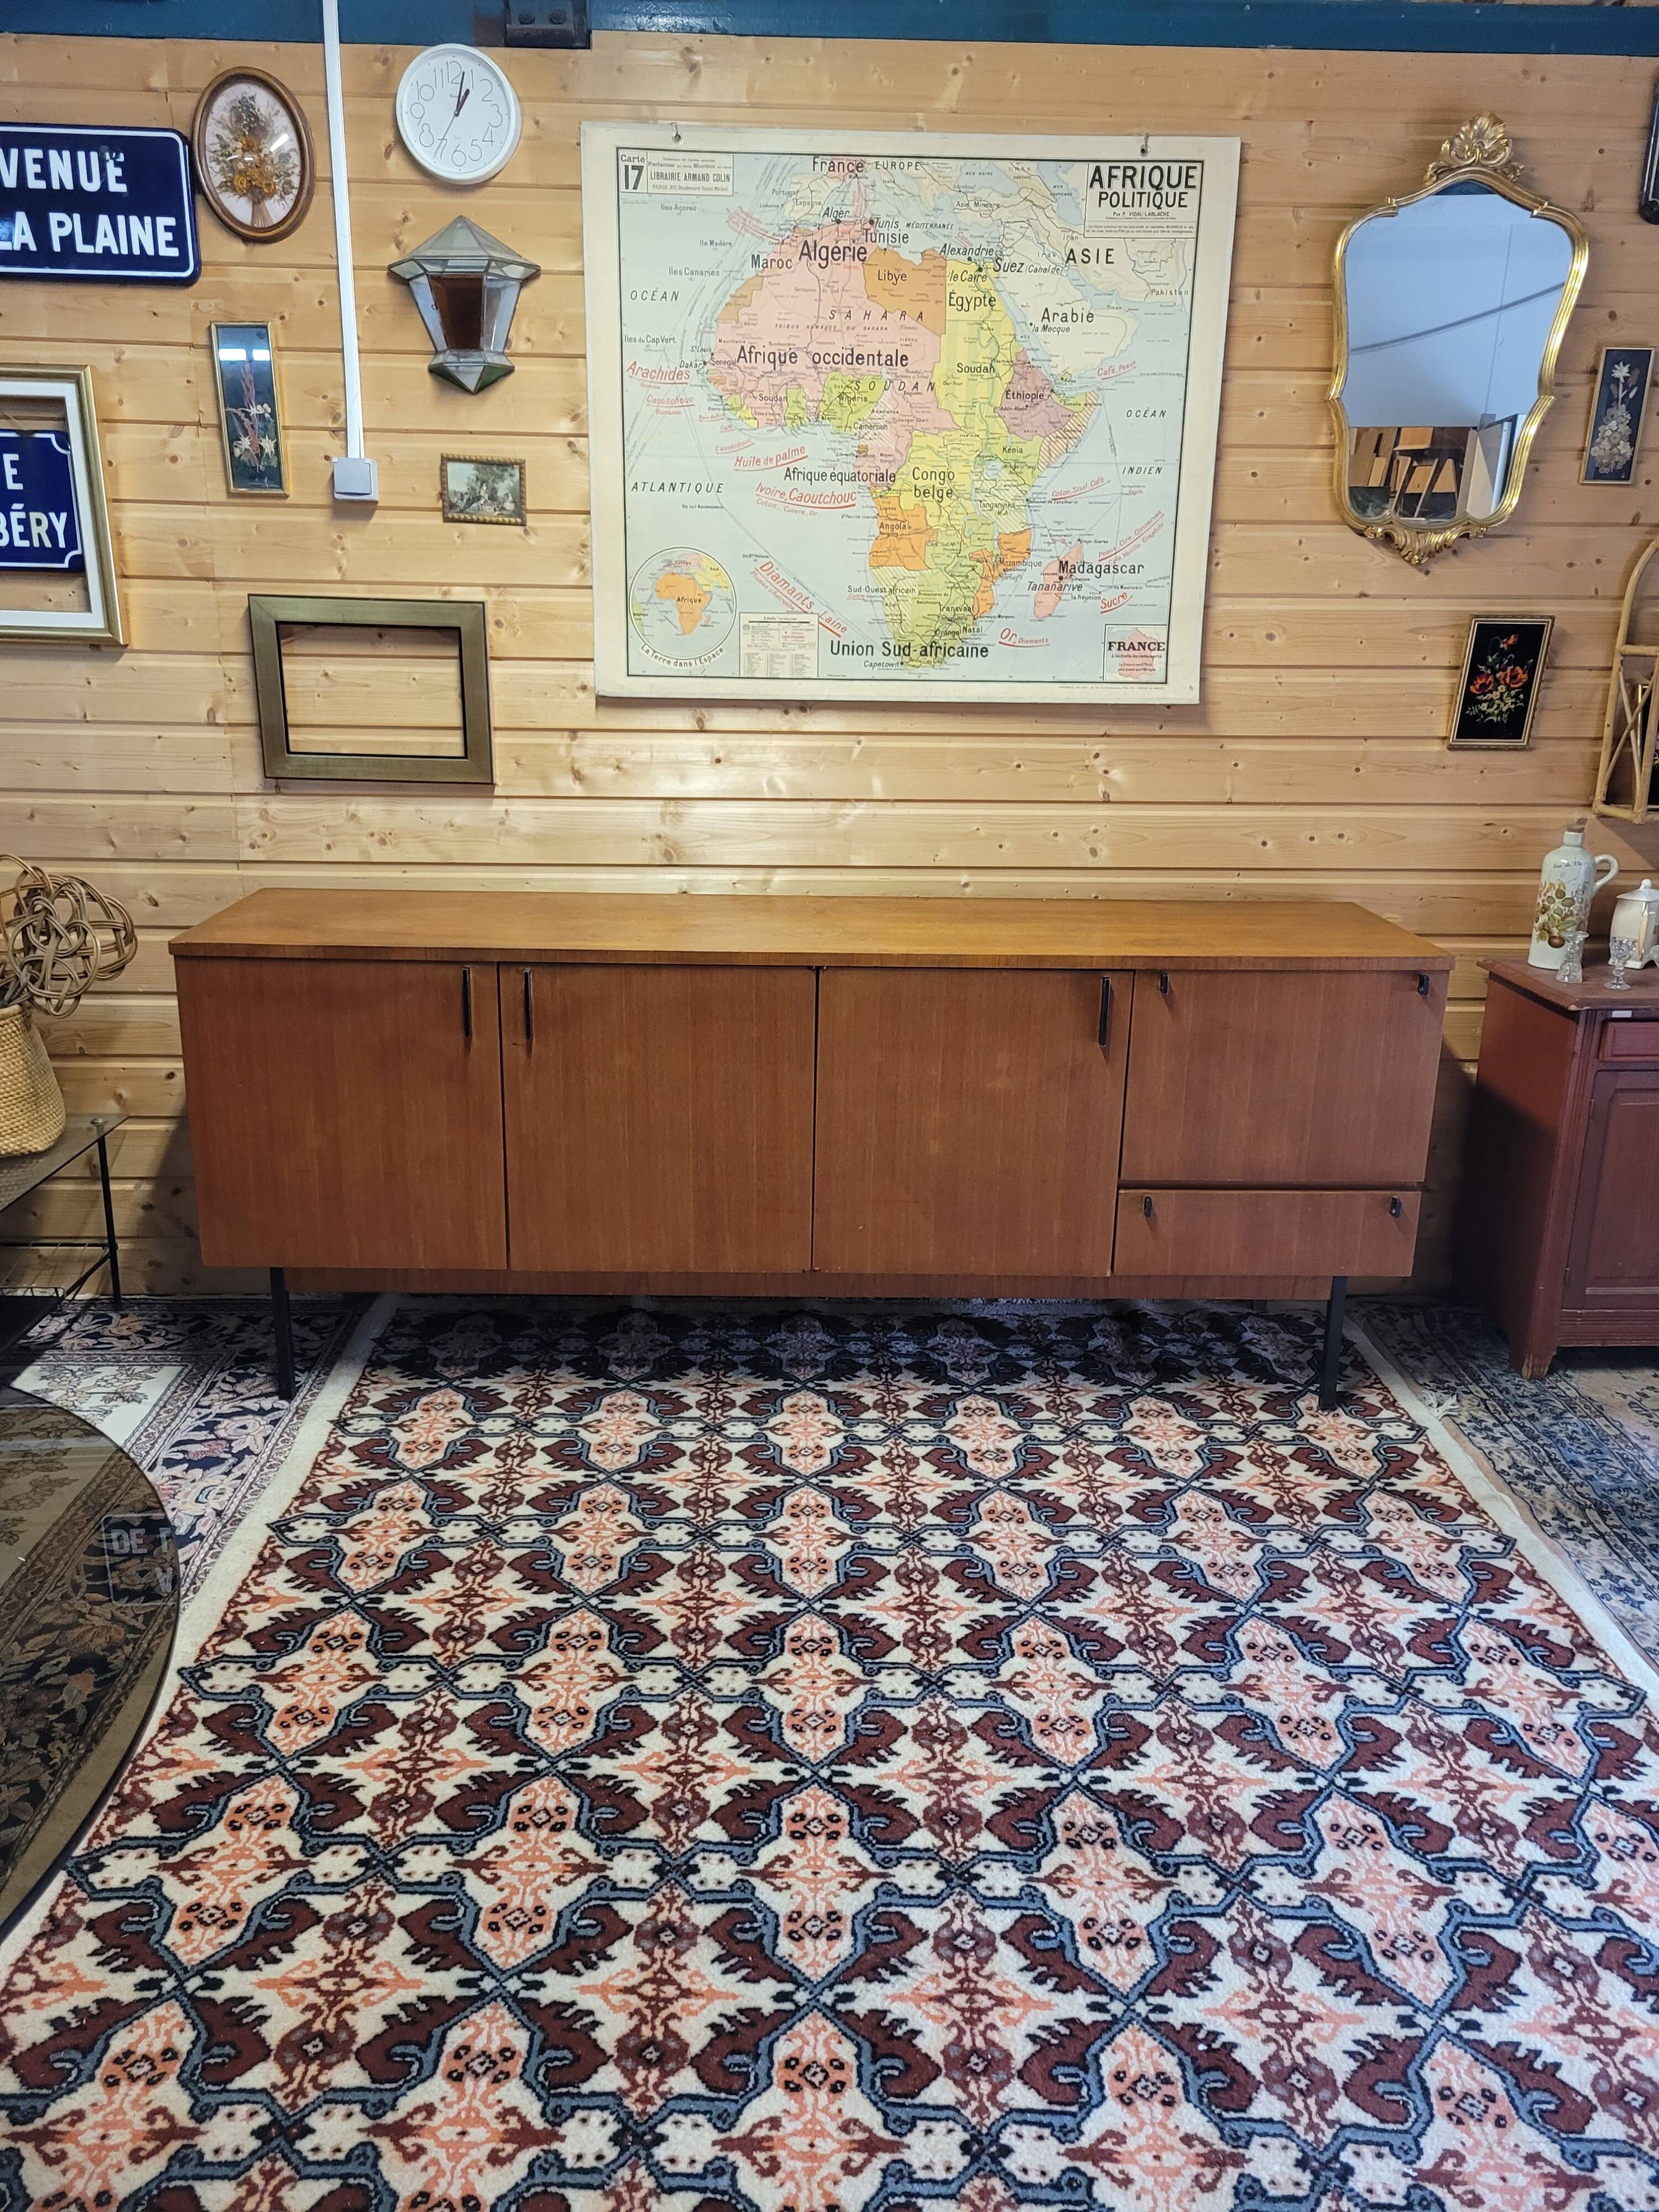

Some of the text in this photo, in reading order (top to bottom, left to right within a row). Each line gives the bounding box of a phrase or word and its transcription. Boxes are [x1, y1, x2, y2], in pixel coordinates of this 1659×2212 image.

[434, 69, 444, 89] 11
[446, 61, 462, 84] 12
[417, 80, 435, 101] 10
[480, 79, 493, 102] 2
[410, 102, 425, 126] 9
[488, 103, 503, 128] 3
[419, 123, 435, 147] 8
[482, 126, 494, 146] 4
[437, 139, 447, 159] 7
[451, 143, 466, 166] 6
[468, 139, 482, 161] 5
[620, 154, 645, 163] Carte
[812, 156, 864, 173] France
[875, 160, 920, 170] EUROPE
[624, 165, 645, 190] 17
[650, 171, 731, 182] LIBRAIRIE ARMAND COLIN
[1089, 165, 1198, 191] AFRIQUE
[772, 190, 800, 198] Portugal
[1098, 191, 1188, 210] POLITIQUE
[822, 207, 850, 222] Alger
[874, 217, 899, 229] Tunis
[906, 222, 954, 230] MÉDITERRANÉE
[49, 212, 179, 257] PLAINE
[862, 228, 910, 244] Tunisie
[799, 240, 868, 269] Algérie
[939, 243, 994, 257] Alexandrie
[1066, 248, 1114, 265] ASIE
[751, 254, 792, 270] Maroc
[993, 258, 1024, 273] Suez
[669, 267, 720, 276] Iles Canaries
[878, 270, 907, 286] Libye
[949, 270, 988, 283] le Caire
[630, 287, 680, 301] OCÉAN
[948, 289, 997, 312] Égypte
[829, 310, 924, 322] SAHARA
[1041, 307, 1094, 323] Arabie
[1032, 324, 1071, 336] la Mecque
[624, 334, 637, 343] Iles
[679, 360, 703, 369] Dakar
[736, 345, 909, 371] Afrique occidentale
[626, 360, 691, 381] Arachides
[956, 362, 995, 374] Soudan
[854, 380, 936, 392] SOUDAN
[646, 394, 694, 405] Caoutchouc
[758, 393, 788, 404] Soudan
[1005, 389, 1045, 404] Éthiopie
[1126, 406, 1167, 418] OCÉAN
[853, 422, 888, 431] Cameroun
[734, 445, 806, 467] Huile de palme
[1002, 445, 1023, 454] Kénia
[3, 453, 24, 490] E
[784, 466, 896, 486] Afrique équatoriale
[912, 467, 955, 486] Congo
[1122, 466, 1162, 474] INDIEN
[631, 482, 724, 494] ATLANTIQUE
[788, 487, 857, 505] Caoutchouc
[914, 484, 954, 503] belge
[978, 500, 1016, 512] Tanganyika
[879, 521, 906, 532] Angola
[999, 557, 1042, 569] Mozambique
[1058, 560, 1144, 578] Madagascar
[847, 585, 916, 594] Sud-Ouest africain
[1027, 581, 1083, 592] Tananarive
[676, 596, 702, 606] Afrique
[1100, 591, 1128, 611] Sucre
[819, 611, 847, 634] Laine
[962, 625, 983, 634] Natal
[830, 640, 989, 658] Union Sud-africaine
[1107, 641, 1165, 651] FRANCE
[641, 644, 724, 667] La Terre dans l'Espace
[863, 660, 901, 670] Capetown
